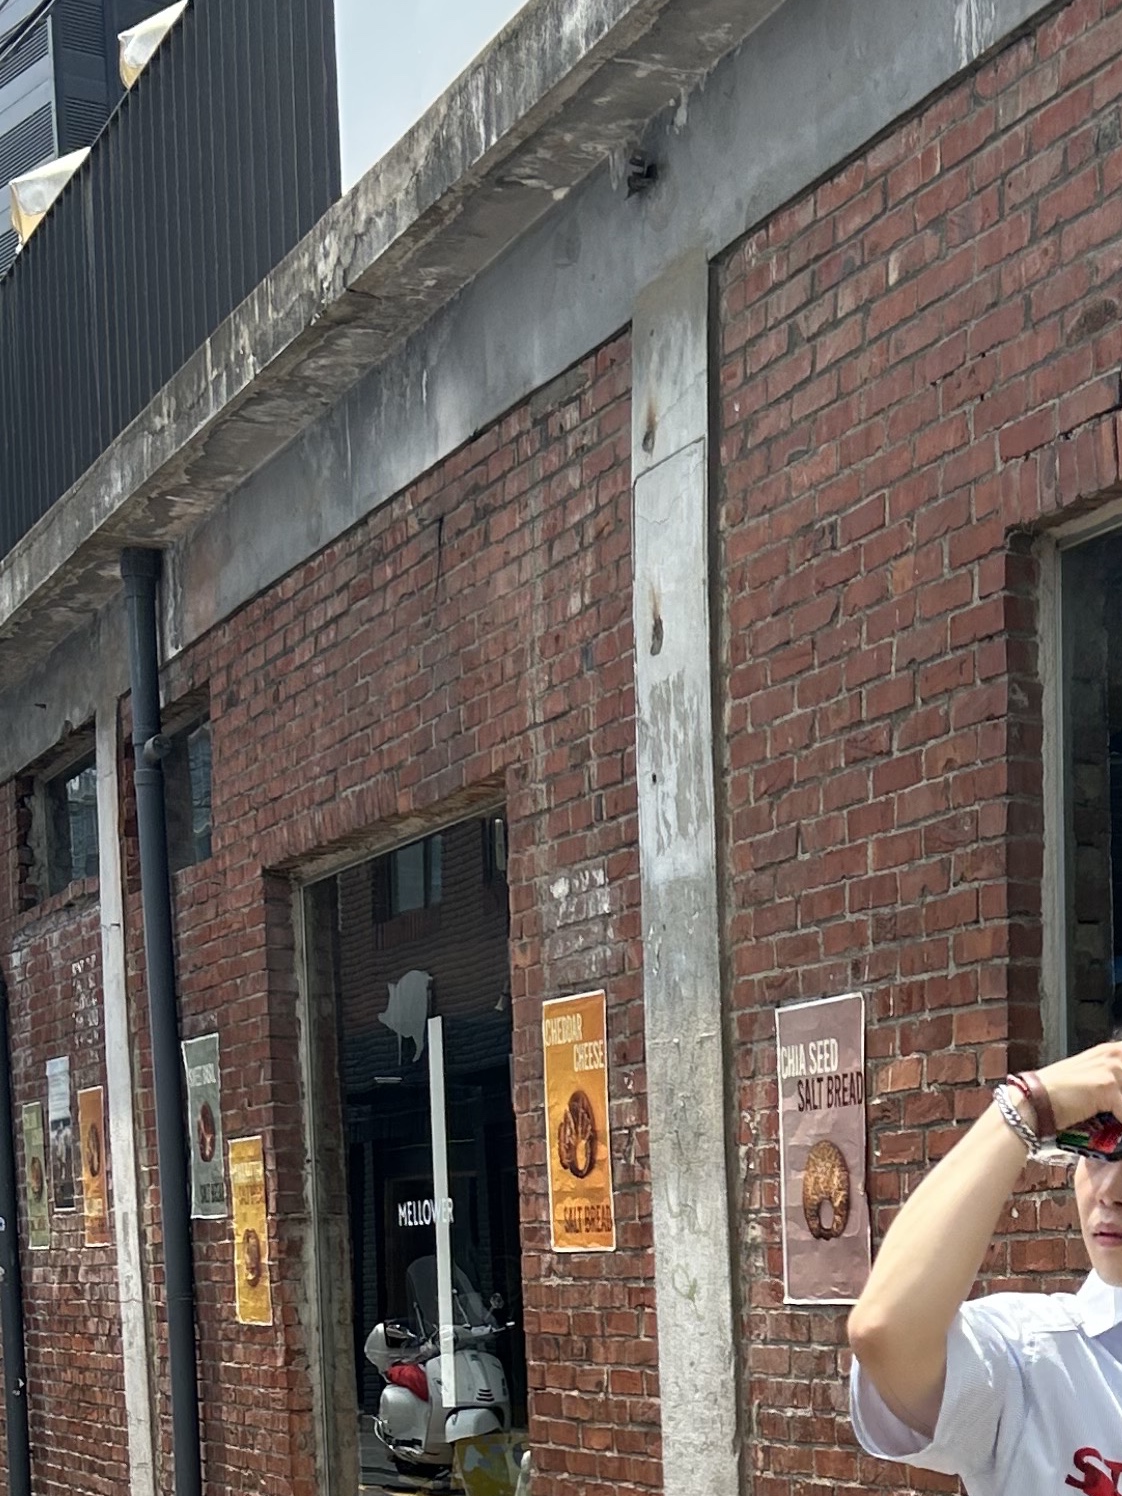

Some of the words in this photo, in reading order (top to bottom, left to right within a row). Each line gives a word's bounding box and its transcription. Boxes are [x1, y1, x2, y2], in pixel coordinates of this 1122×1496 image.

[545, 1012, 583, 1047] CHEDDAR
[573, 1039, 605, 1072] CHEESE
[781, 1043, 807, 1079] CHIA
[809, 1038, 839, 1075] SEED
[797, 1077, 824, 1112] SALT
[826, 1071, 864, 1109] BREAD
[398, 1197, 455, 1226] MELLOWER
[584, 1204, 613, 1233] BREAD
